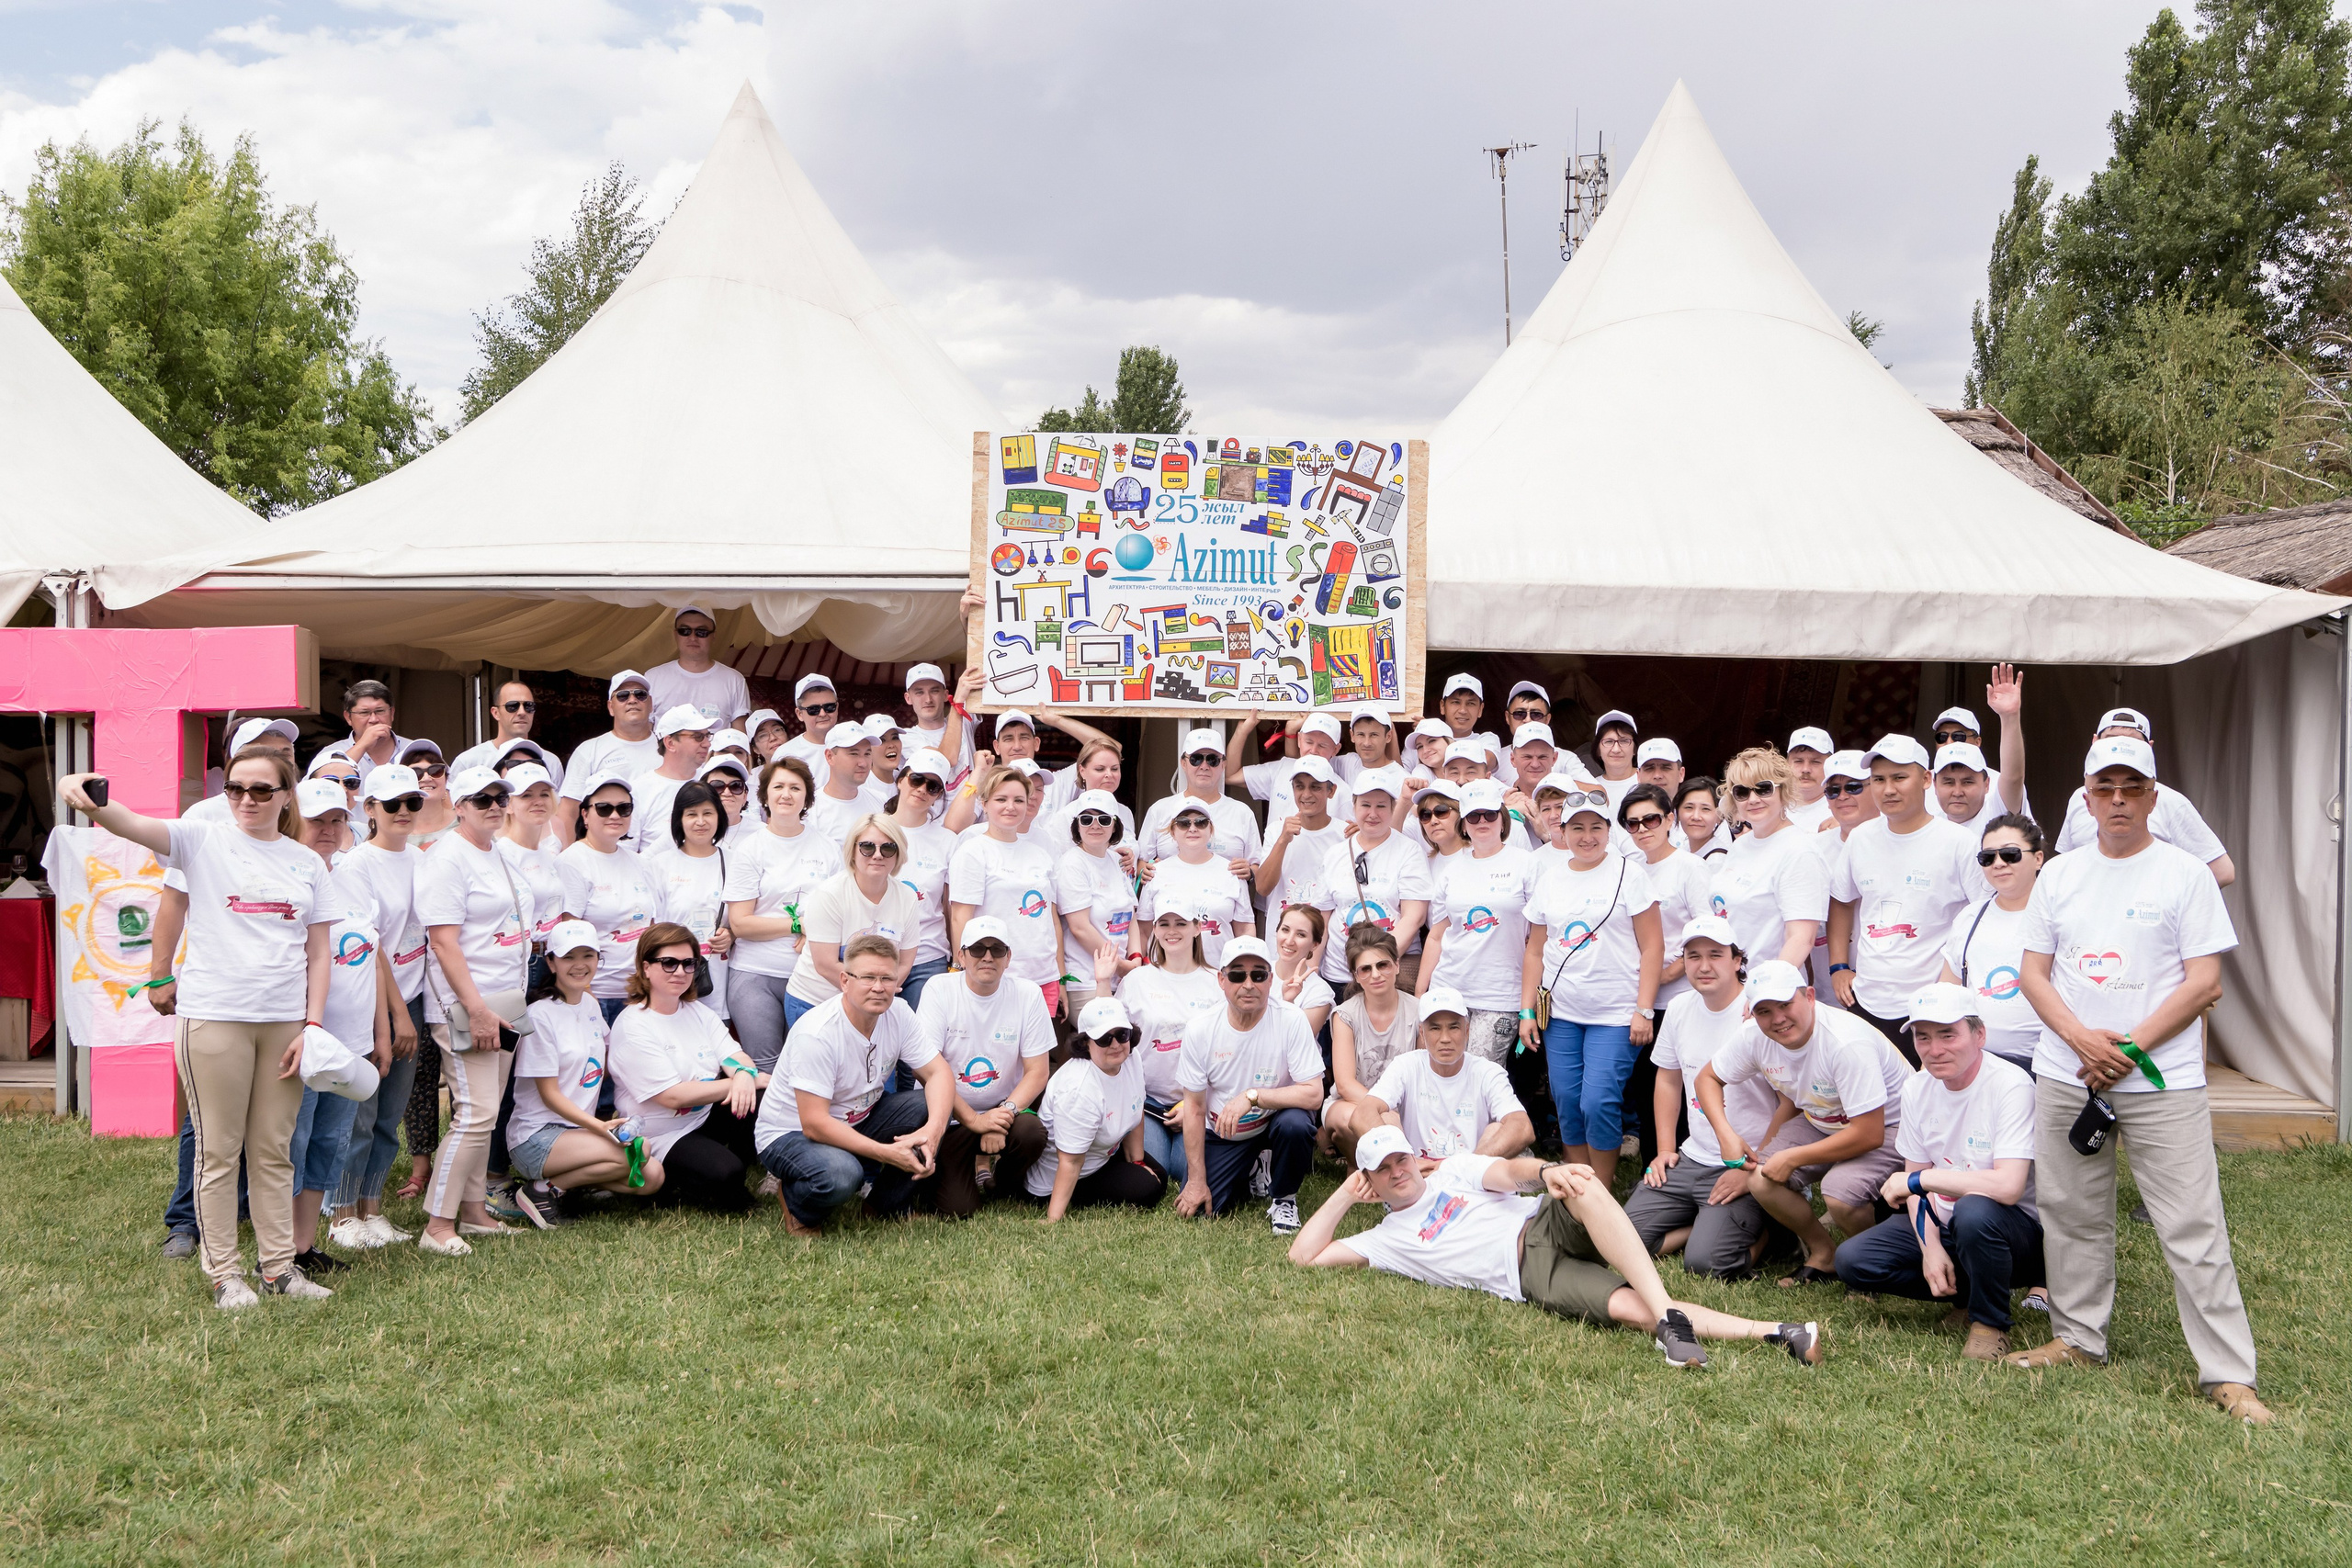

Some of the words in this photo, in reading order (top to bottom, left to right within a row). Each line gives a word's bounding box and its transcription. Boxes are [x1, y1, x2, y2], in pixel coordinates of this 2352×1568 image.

[1155, 493, 1199, 524] 25
[1202, 502, 1244, 513] жыл
[1001, 513, 1044, 526] Azimut
[1047, 518, 1067, 529] 25
[1201, 513, 1237, 525] лет
[1168, 532, 1278, 586] Azimut
[1192, 593, 1228, 606] Since
[1232, 595, 1261, 607] 1993
[2137, 908, 2161, 920] Azimut
[2104, 977, 2144, 991] Azimut
